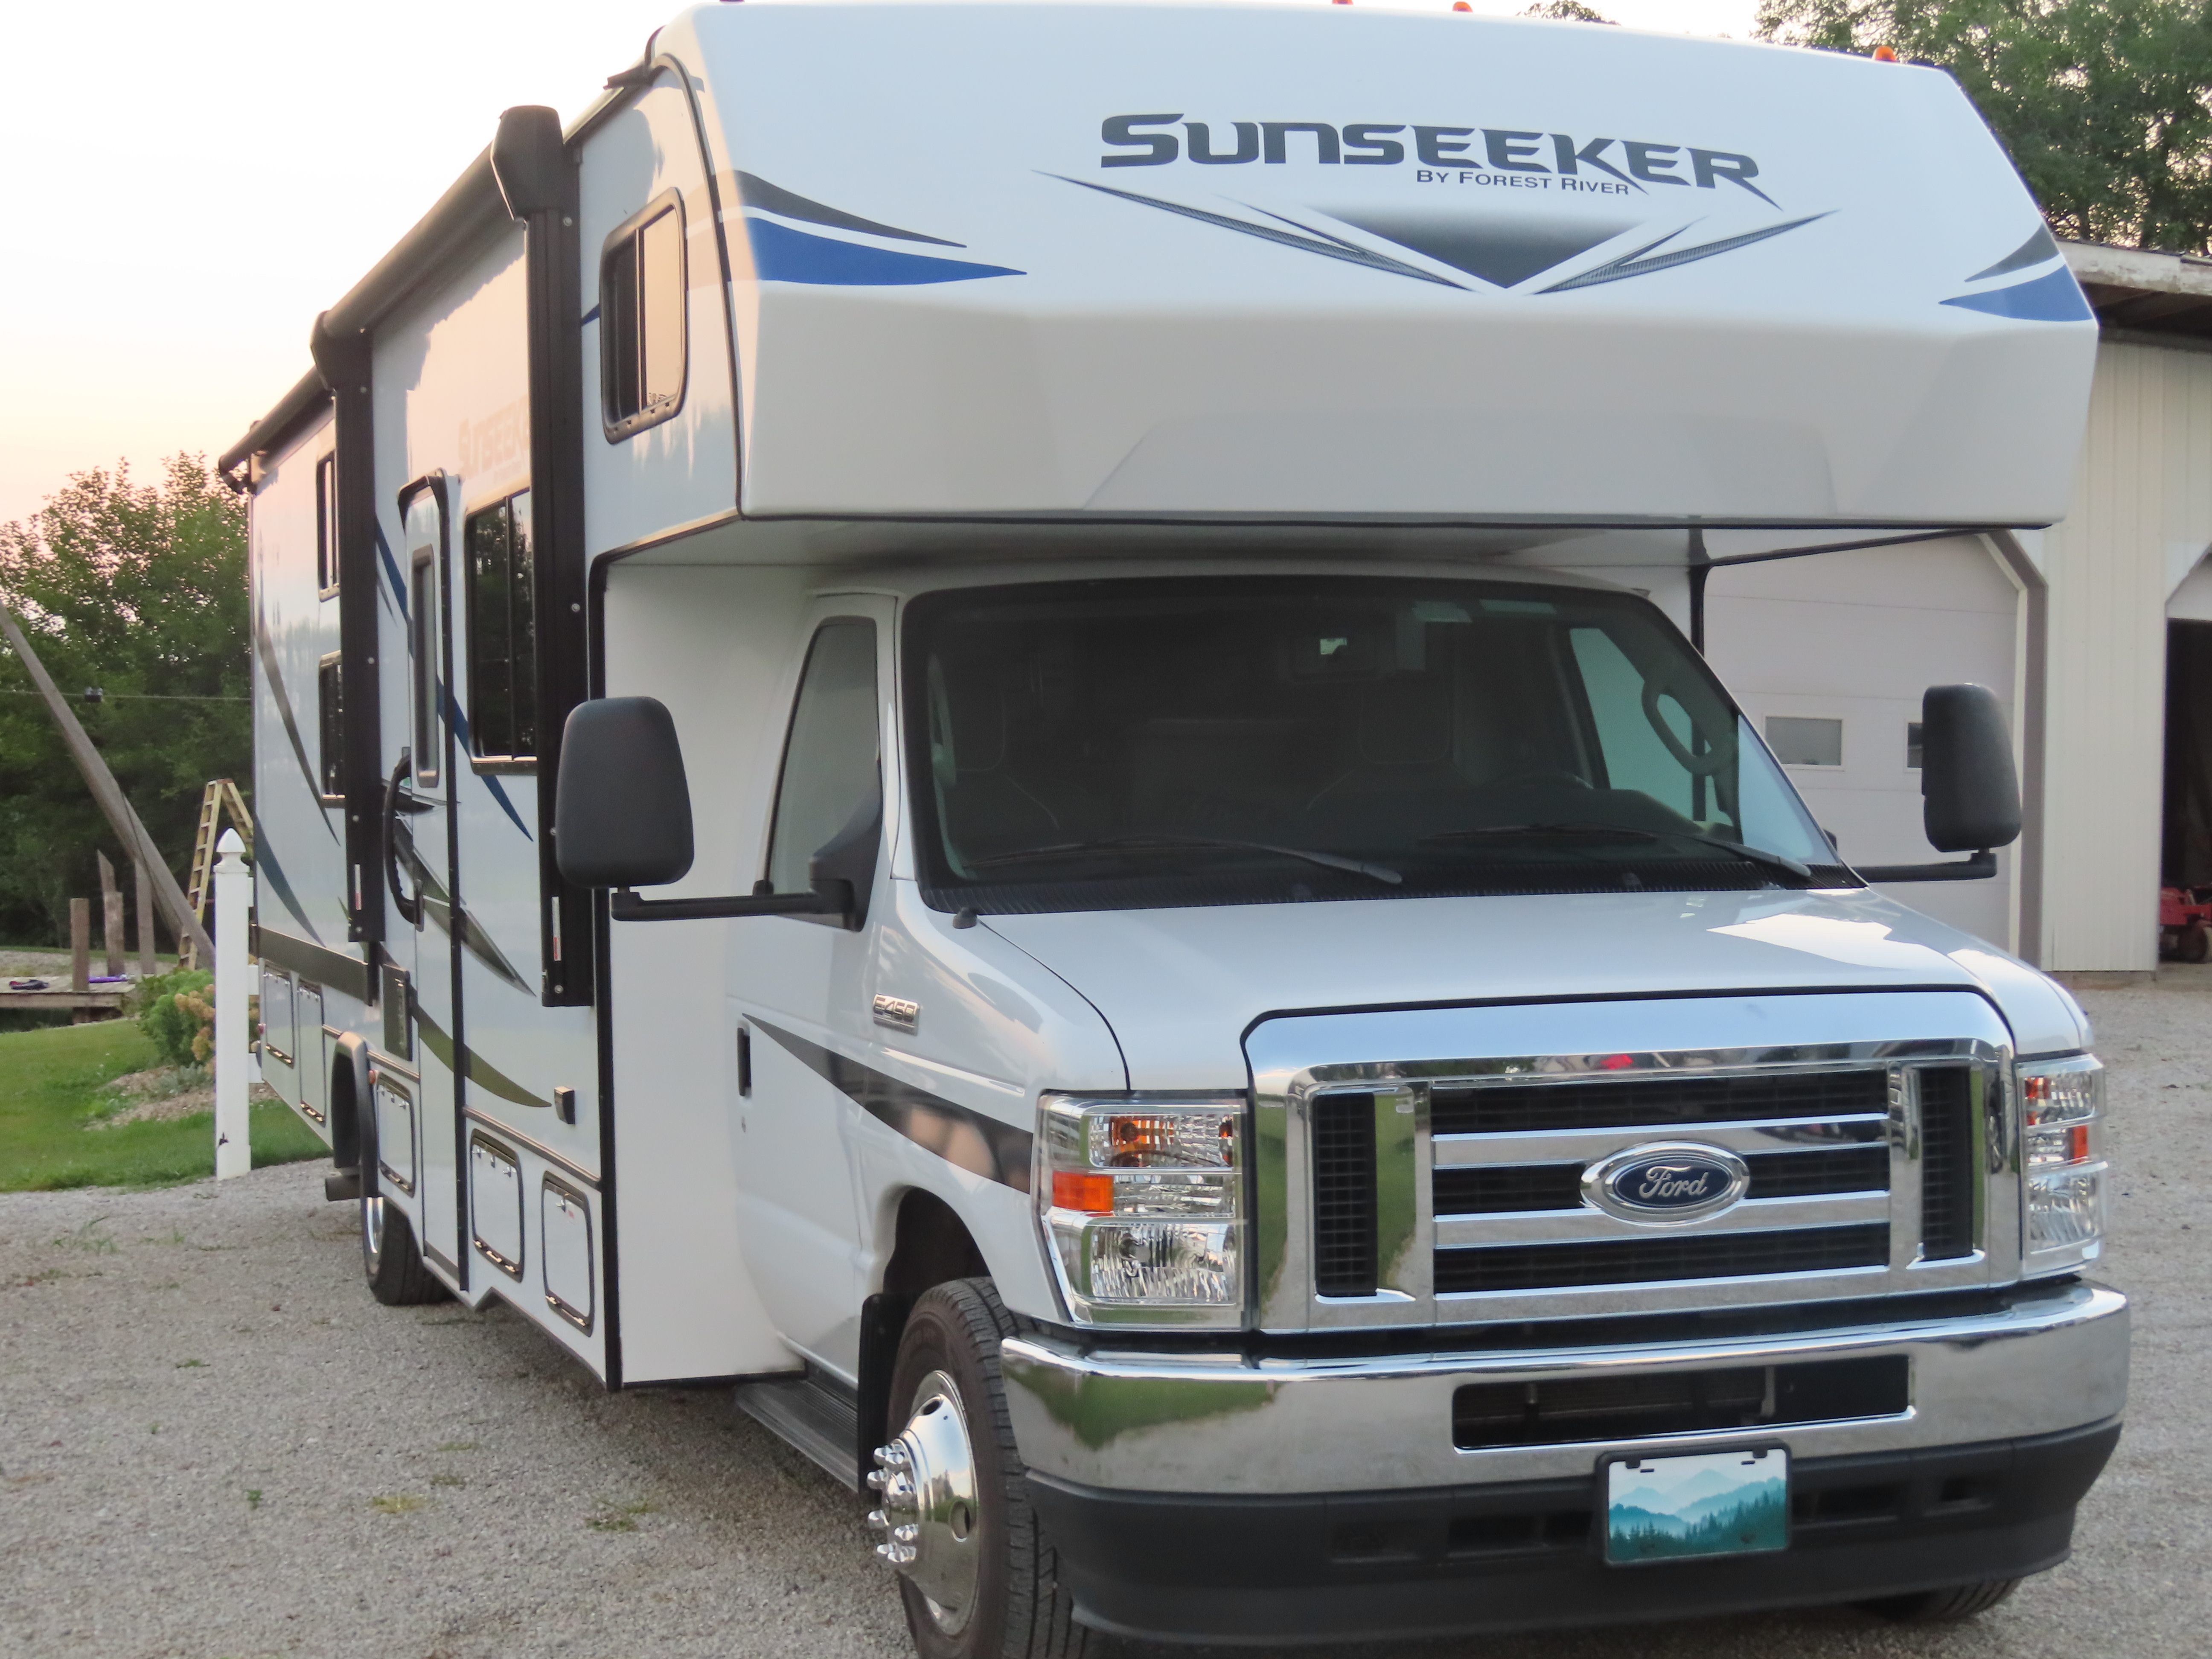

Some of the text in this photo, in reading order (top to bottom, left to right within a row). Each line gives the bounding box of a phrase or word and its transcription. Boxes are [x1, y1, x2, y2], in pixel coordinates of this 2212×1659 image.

[1101, 113, 1784, 212] SUNSEEKER
[1416, 170, 1630, 195] BY FOREST RIVER
[1639, 1165, 1709, 1199] Ford
